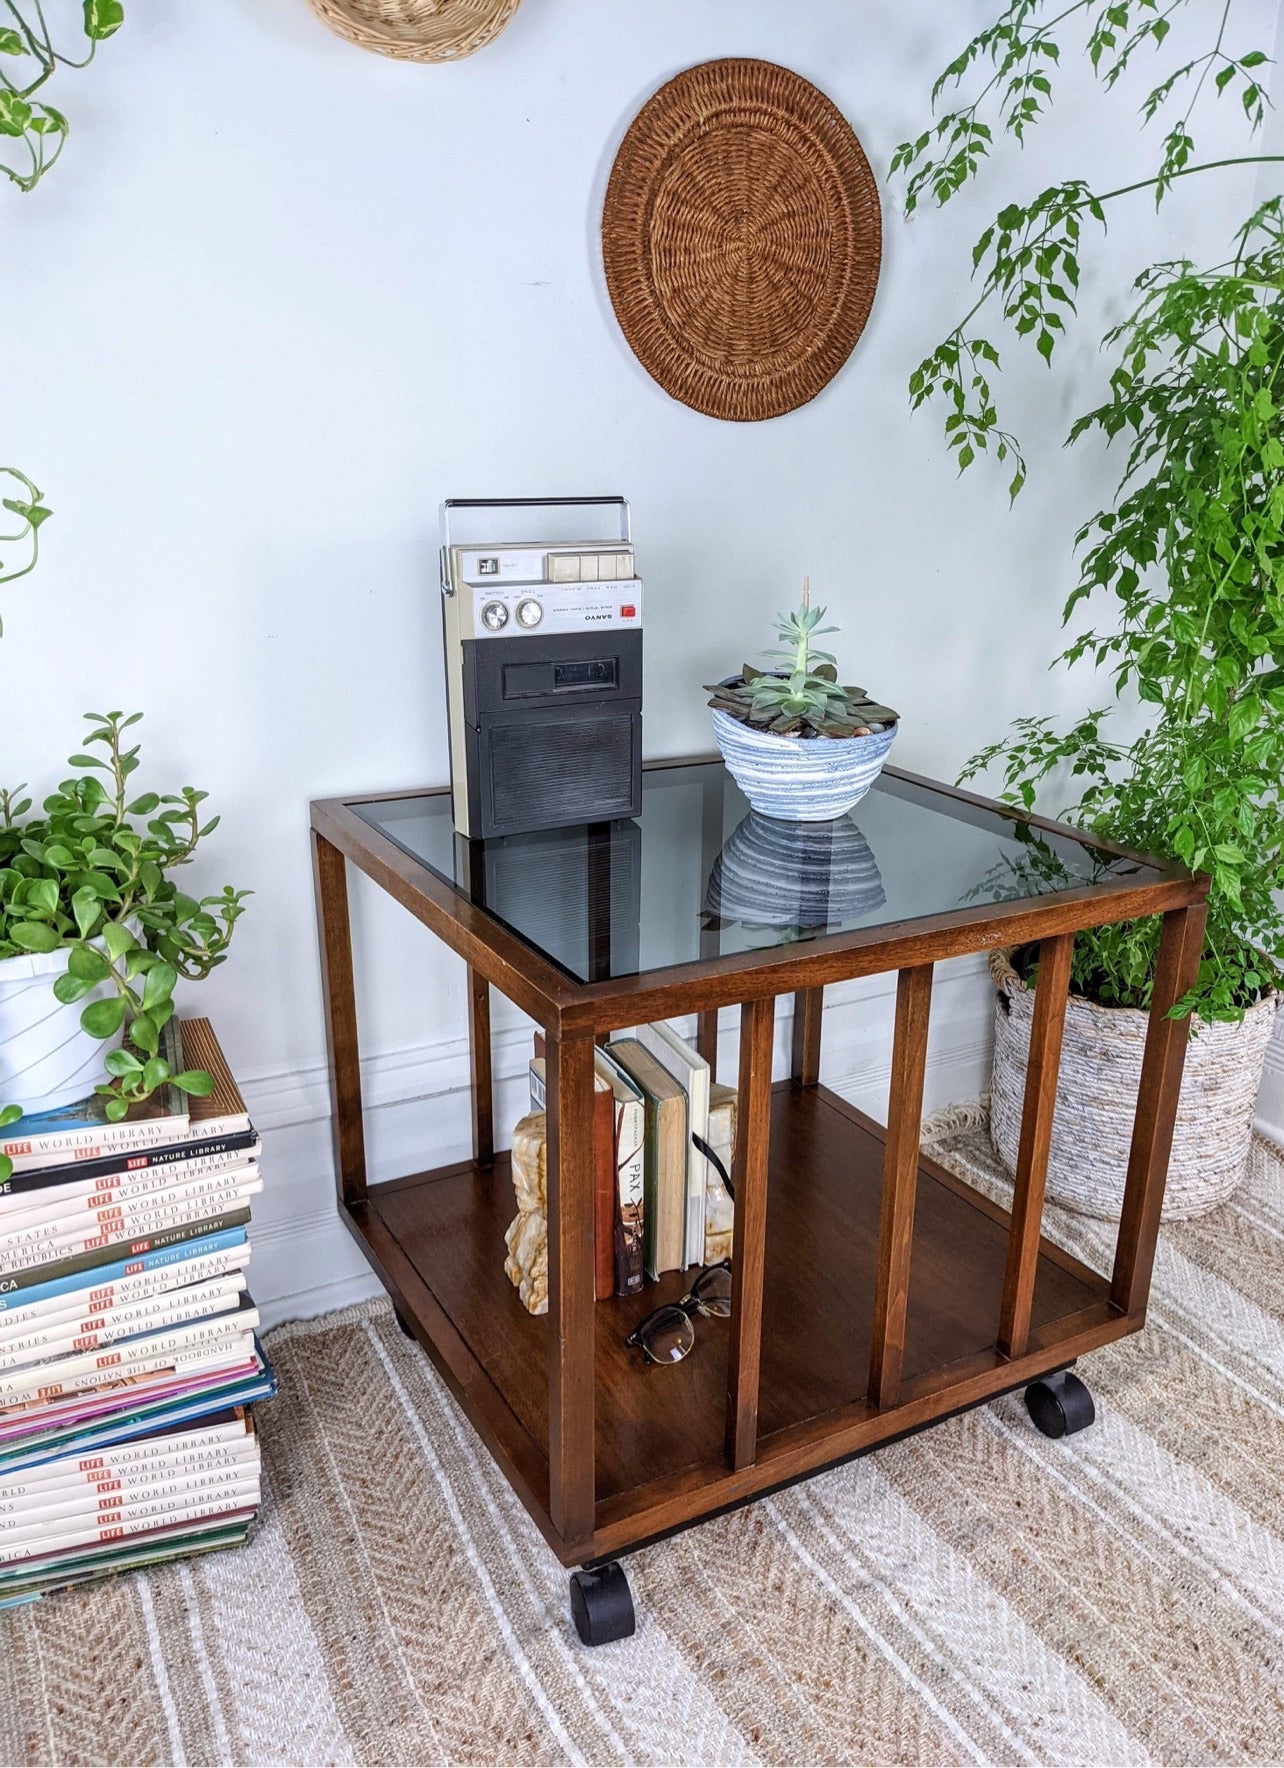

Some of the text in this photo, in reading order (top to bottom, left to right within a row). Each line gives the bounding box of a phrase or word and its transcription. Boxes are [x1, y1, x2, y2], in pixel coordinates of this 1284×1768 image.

[4, 1125, 162, 1155] LIFE WORLD LIBRARY
[75, 1147, 100, 1160] LIFE
[107, 1138, 158, 1152] WORLD
[127, 1156, 148, 1170] LIFE
[152, 1150, 186, 1163] NATURE
[190, 1144, 226, 1156] LIBRARY
[96, 1150, 240, 1190] LIFE WORLD LIBRARY
[629, 1163, 641, 1192] PAX
[88, 1192, 112, 1208] LIFE
[118, 1177, 166, 1198] WORLD
[7, 1176, 238, 1246] STATES LIFE WORLD LIBRARY
[100, 1218, 124, 1234] LIFE
[130, 1206, 178, 1225] WORLD
[187, 1189, 240, 1210] LIBRARY
[11, 1245, 73, 1270] REPUBLICS
[84, 1234, 108, 1250] LIFE
[115, 1222, 163, 1240] WORLD
[172, 1204, 225, 1225] LIBRARY
[130, 1241, 151, 1254] LIFE
[154, 1232, 186, 1246] NATURE
[190, 1220, 224, 1236] LIBRARY
[124, 1262, 144, 1276] LIFE
[148, 1253, 180, 1267] NATURE
[184, 1243, 218, 1257] LIBRARY
[89, 1264, 228, 1314] LIFE WORLD LIBRARY
[90, 1286, 114, 1302] LIFE
[120, 1272, 168, 1292] WORLD
[177, 1254, 230, 1276] LIBRARY
[73, 1334, 98, 1350] LIFE
[104, 1322, 153, 1340] WORLD
[162, 1304, 216, 1325] LIBRARY
[81, 1318, 105, 1334] LIFE
[112, 1304, 160, 1323] WORLD
[170, 1287, 223, 1308] LIBRARY
[96, 1352, 121, 1368] LIFE
[127, 1338, 176, 1358] WORLD
[185, 1322, 240, 1343] LIBRARY
[172, 1343, 233, 1363] HANDBOOK
[74, 1370, 122, 1388] NATIONS
[127, 1365, 146, 1376] THE
[154, 1360, 167, 1370] OF
[38, 1384, 62, 1398] LIFE
[80, 1435, 222, 1472] LIFE WORLD LIBRARY
[87, 1469, 111, 1482] LIFE
[118, 1460, 166, 1476] WORLD
[175, 1447, 229, 1464] LIBRARY
[97, 1480, 121, 1494] LIFE
[128, 1469, 176, 1485] WORLD
[184, 1456, 238, 1473] LIBRARY
[99, 1496, 122, 1509] LIFE
[130, 1485, 177, 1501] WORLD
[186, 1472, 240, 1488] LIBRARY
[97, 1488, 238, 1524] LIFE WORLD LIBRARY
[100, 1527, 124, 1540] LIFE
[130, 1516, 177, 1532] WORLD
[186, 1501, 240, 1520] LIBRARY
